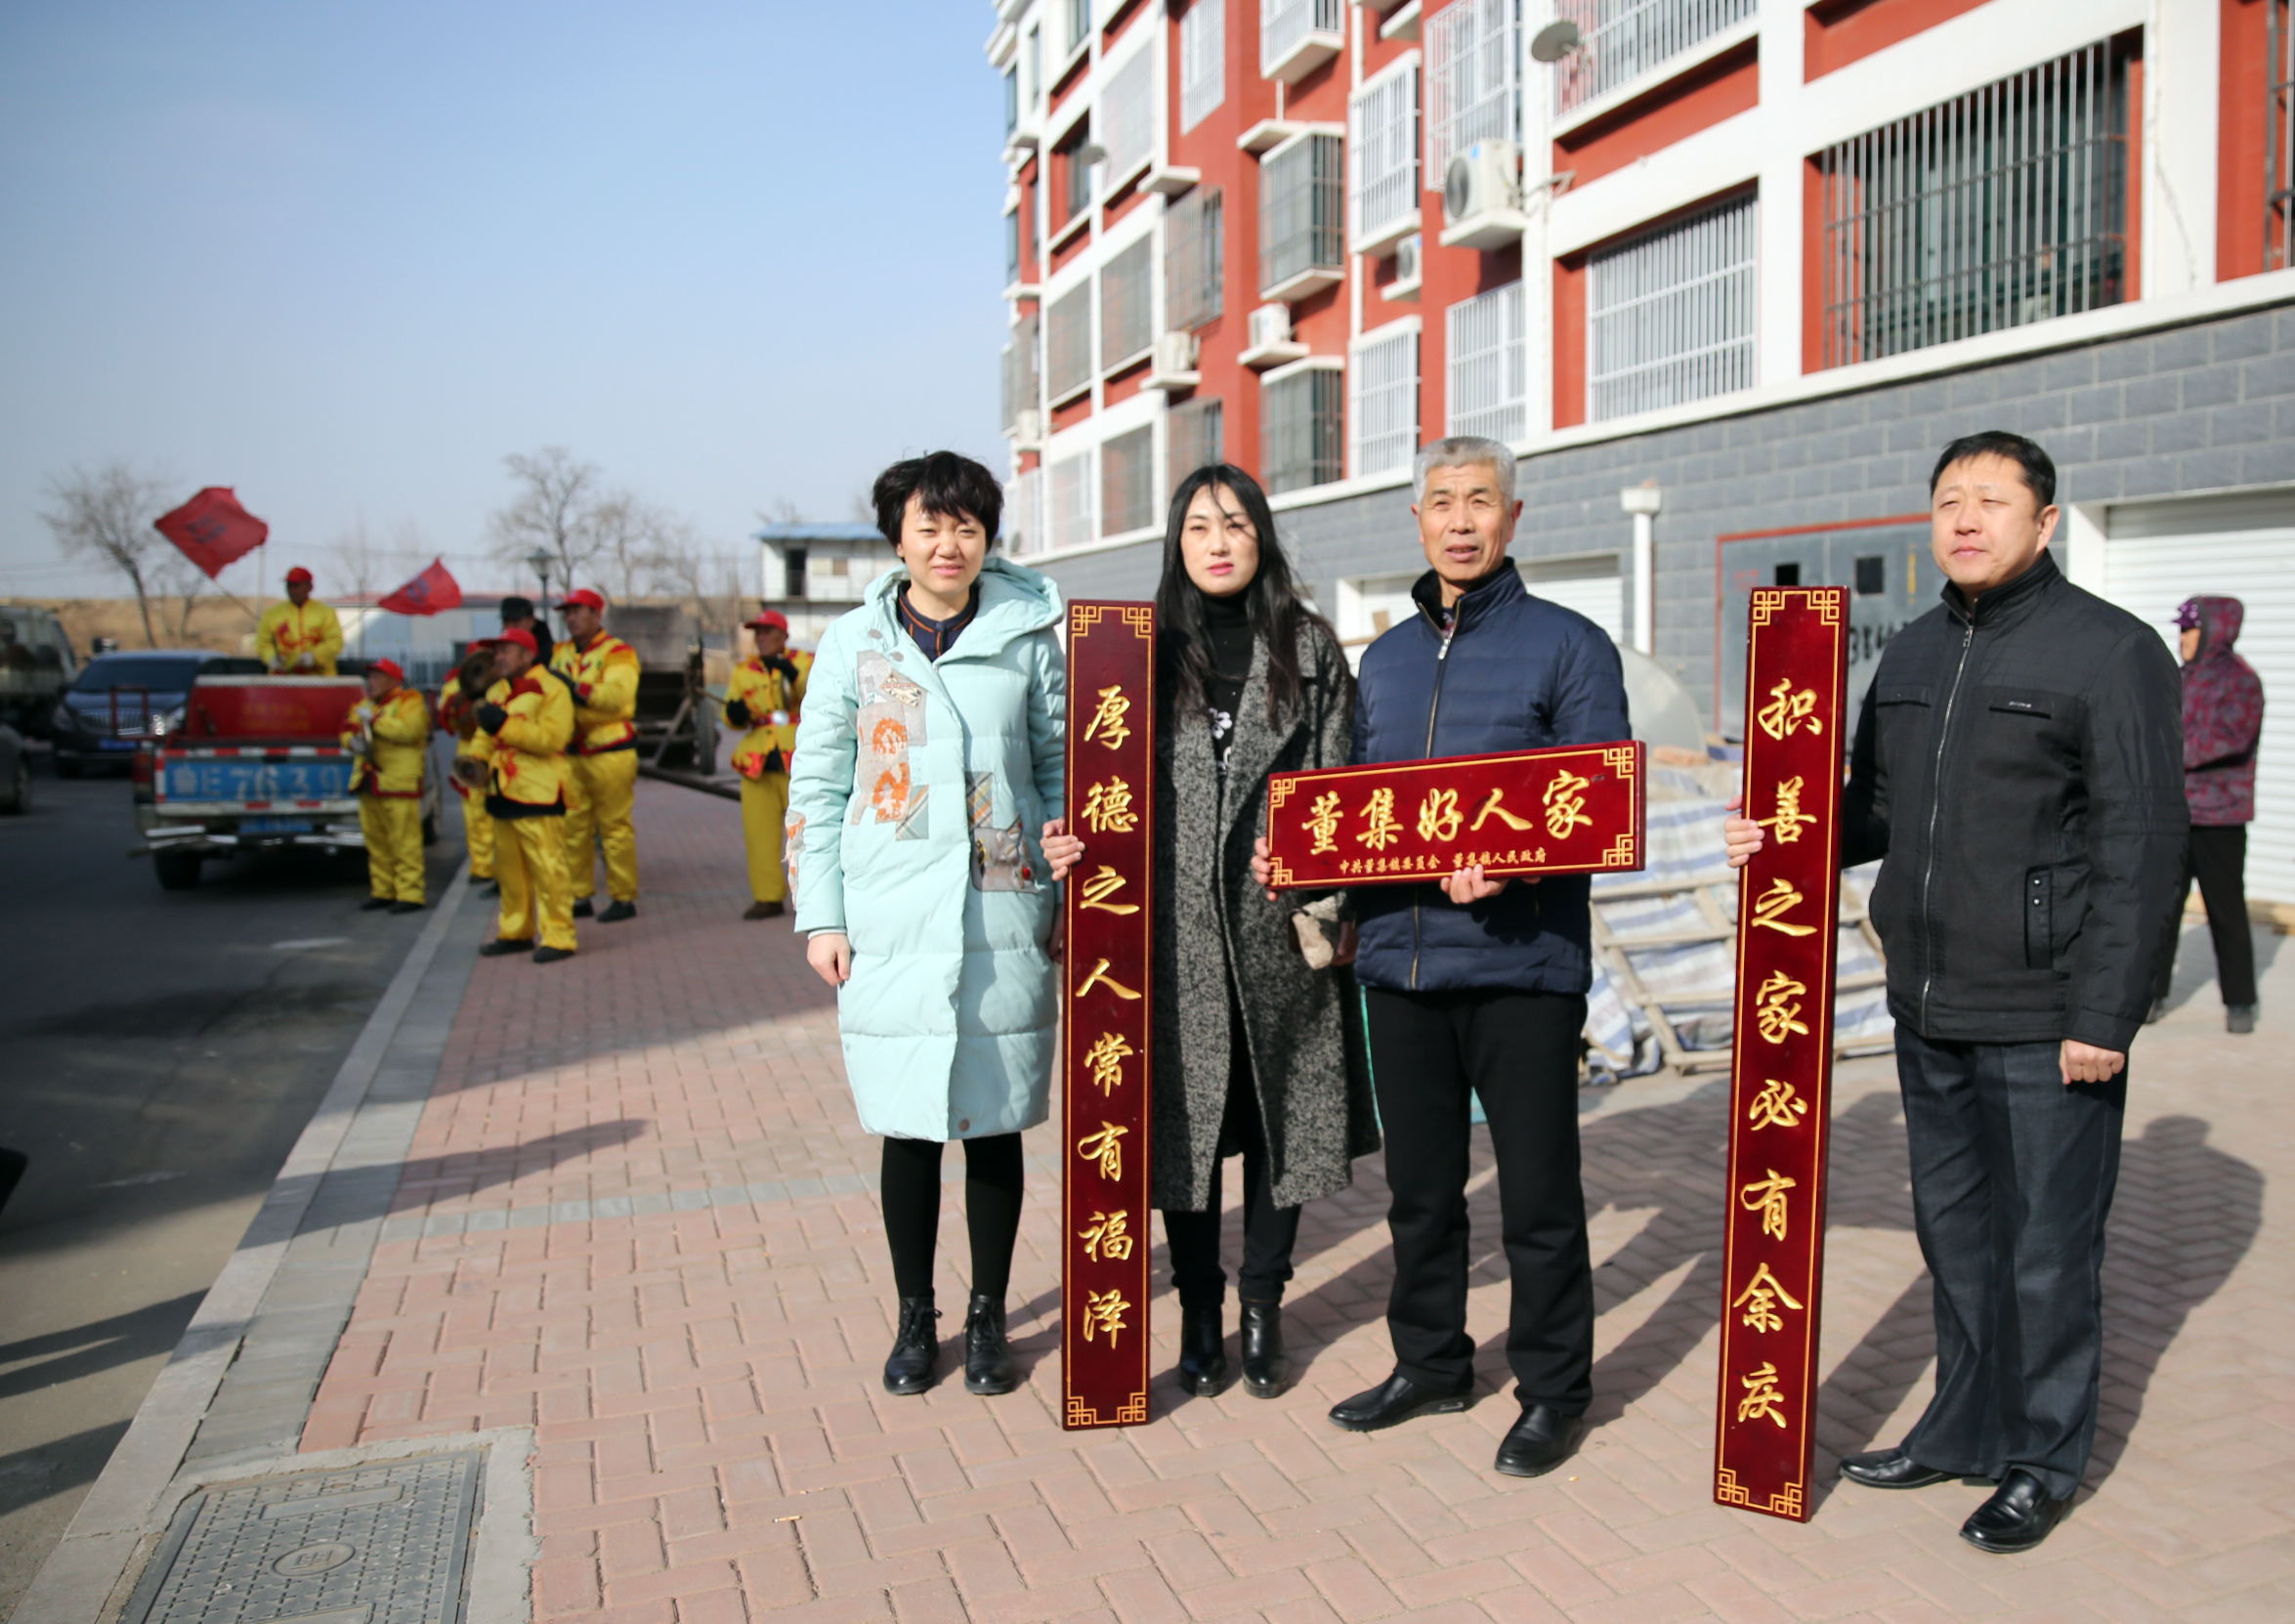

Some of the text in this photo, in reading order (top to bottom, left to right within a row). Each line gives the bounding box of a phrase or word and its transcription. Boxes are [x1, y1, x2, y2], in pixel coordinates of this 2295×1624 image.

[1301, 769, 1594, 855] 董集好人家
[1339, 846, 1548, 875] 中共董集镇委员会 董集镇人民政府
[1076, 684, 1142, 1349] 厚德之人常有福泽
[1732, 677, 1823, 1429] 积善之家必有余庆
